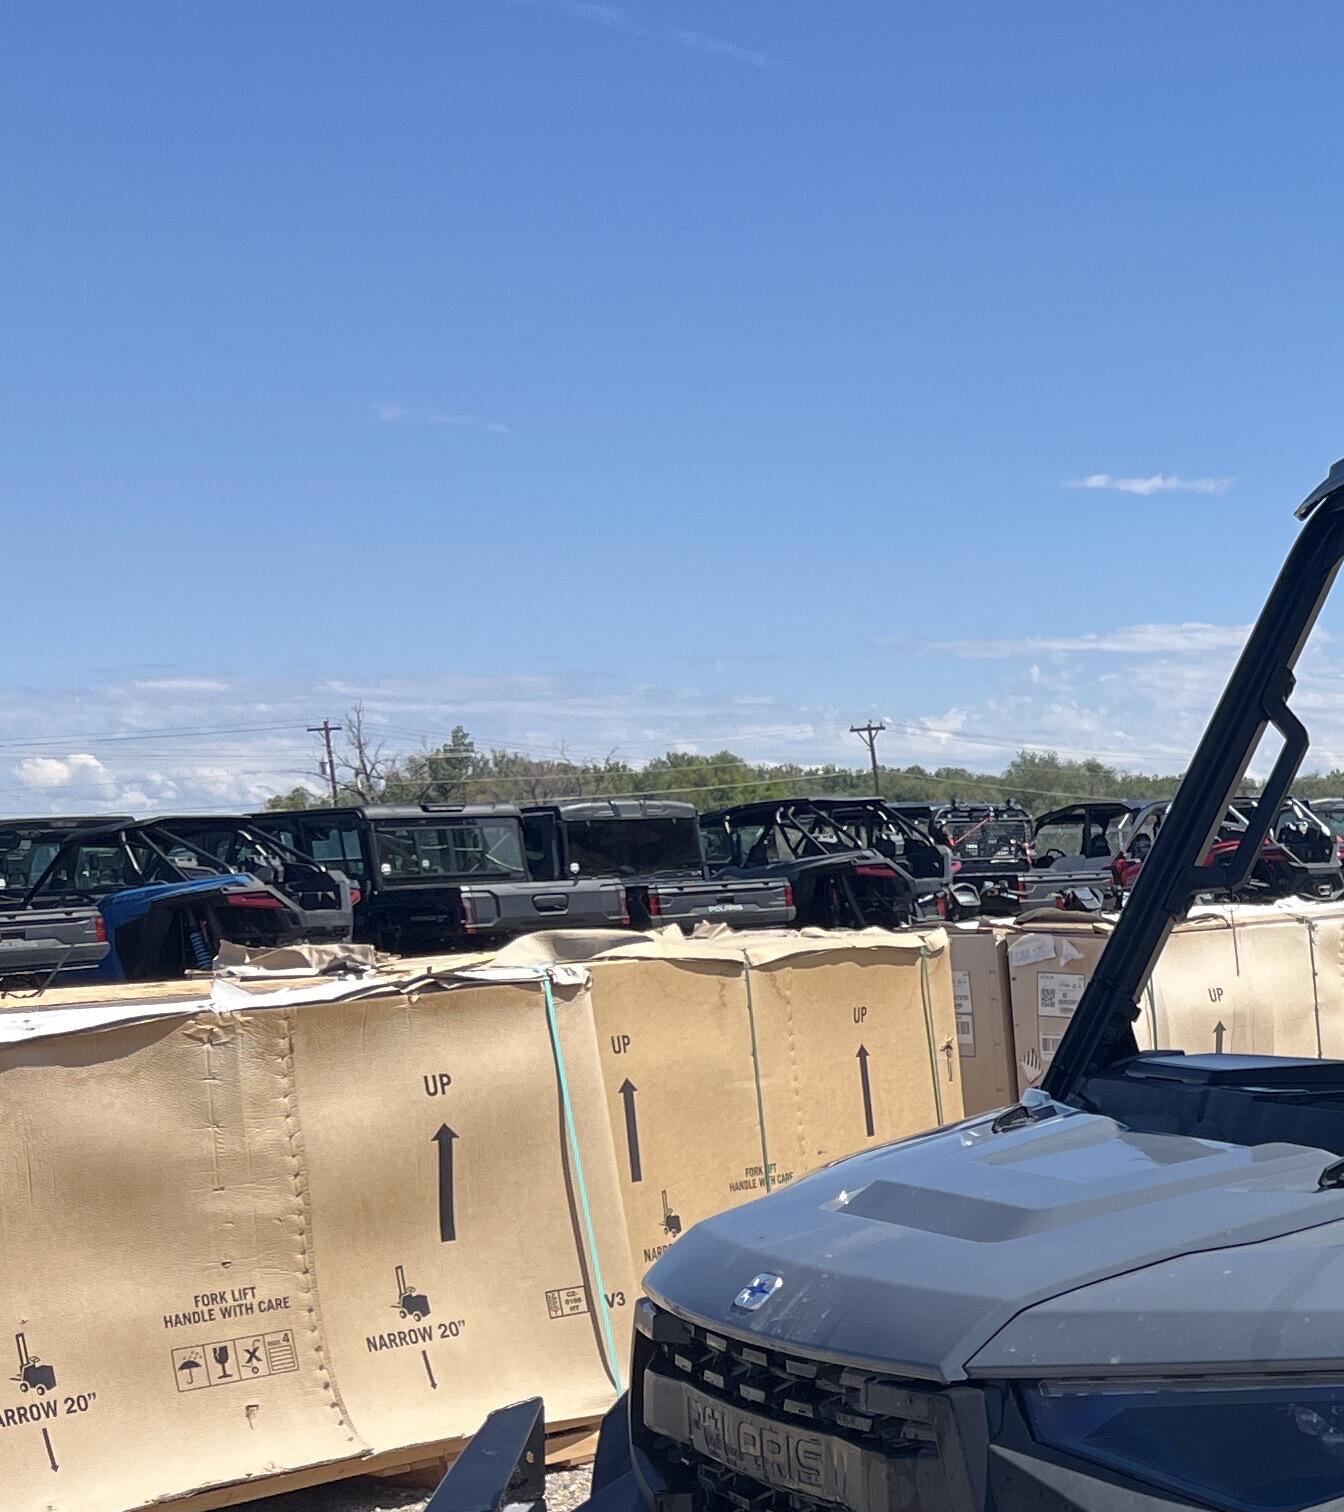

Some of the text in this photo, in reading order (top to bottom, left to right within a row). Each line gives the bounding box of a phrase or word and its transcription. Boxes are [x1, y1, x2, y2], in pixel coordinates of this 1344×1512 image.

[1207, 987, 1224, 1003] UP
[853, 1006, 868, 1024] UP
[610, 1034, 631, 1055] UP
[423, 1072, 452, 1097] UP
[729, 1178, 758, 1192] HANDLE
[193, 1286, 257, 1309] FORK LIFT
[604, 1291, 626, 1309] V3
[163, 1296, 291, 1329] HANDLE WITH CARE
[365, 1325, 433, 1353] NARROW
[0, 1399, 58, 1428] ARROW
